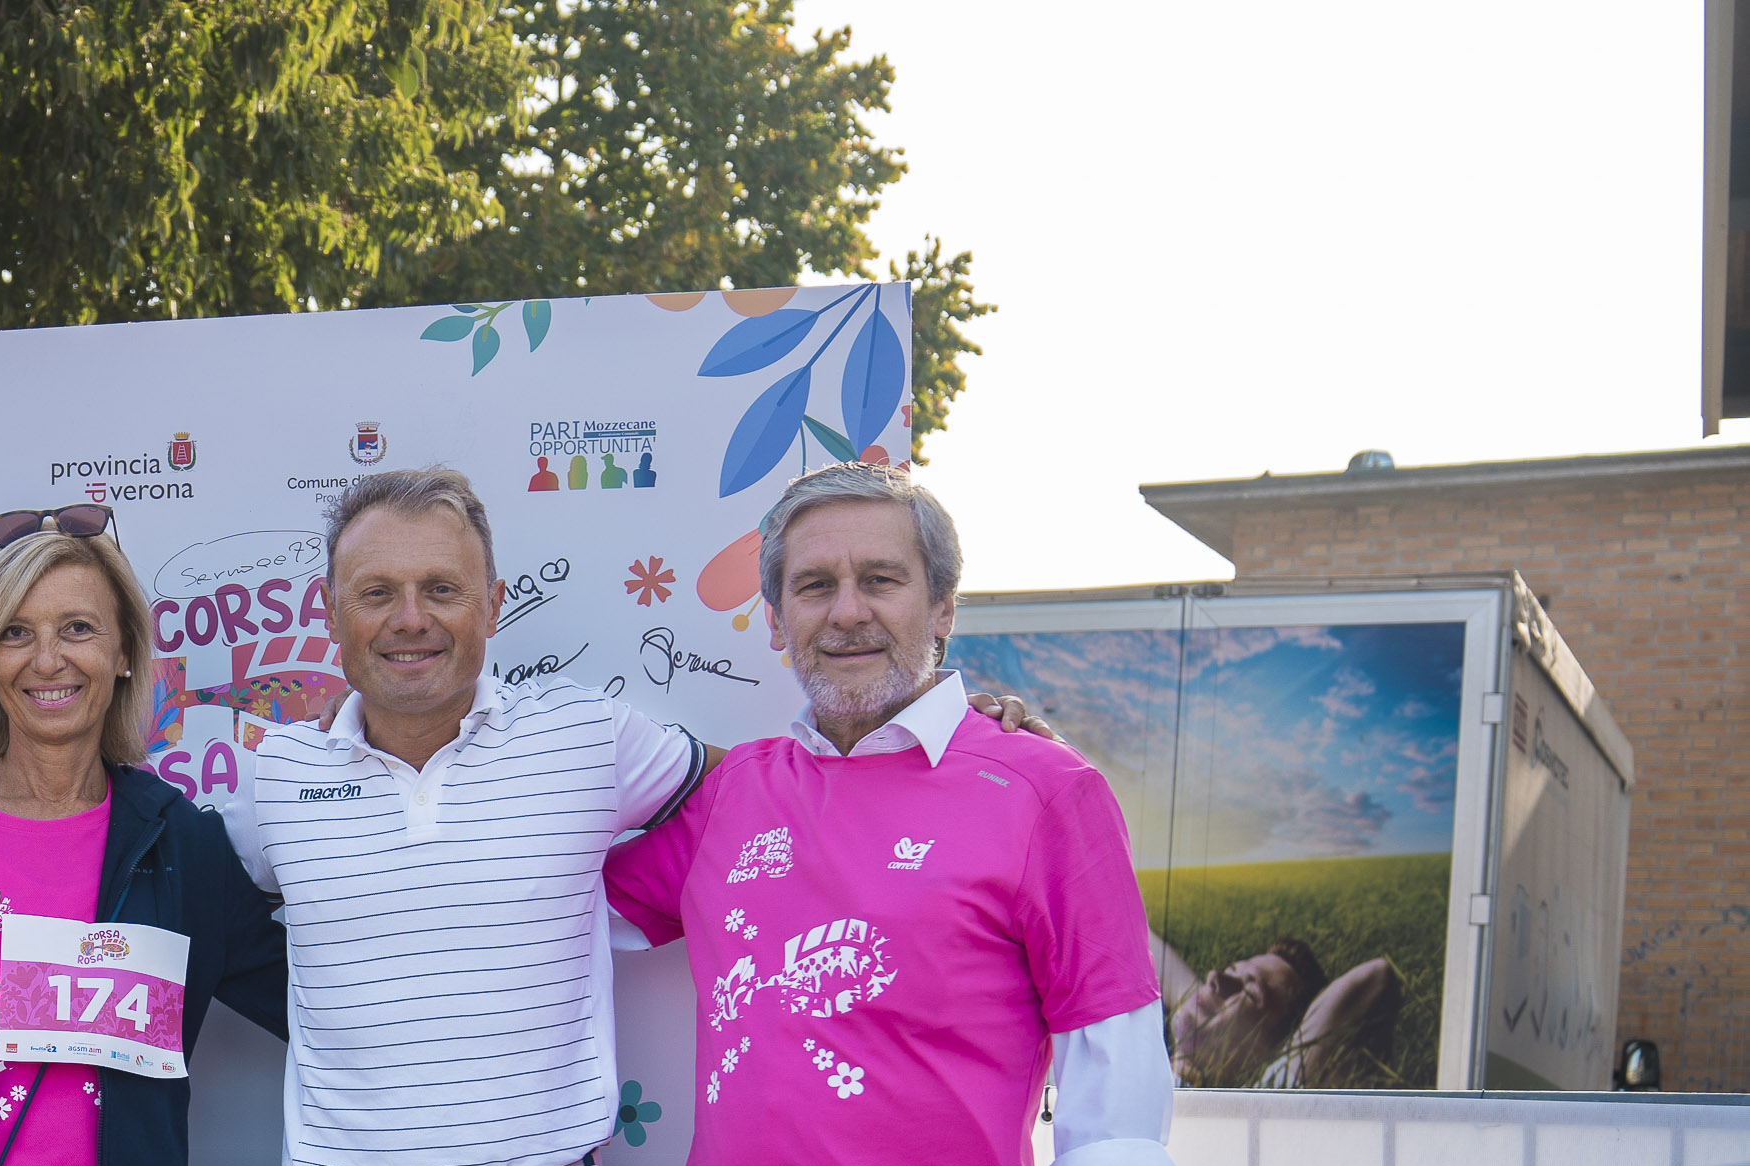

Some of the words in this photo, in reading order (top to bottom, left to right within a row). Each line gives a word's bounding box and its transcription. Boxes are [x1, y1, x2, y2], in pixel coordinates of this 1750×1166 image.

[530, 420, 580, 441] PARI
[583, 420, 656, 431] Mozzecane
[530, 437, 656, 456] OPPORTUNITA'
[51, 453, 162, 485] provincia
[110, 482, 195, 501] verona
[287, 477, 348, 489] Comune
[150, 577, 330, 653] CORSA
[140, 741, 238, 801] SA
[752, 826, 788, 846] CORSA
[726, 866, 759, 884] ROSA
[88, 929, 120, 941] CORSA
[77, 953, 104, 965] ROSA
[48, 974, 151, 1033] 174
